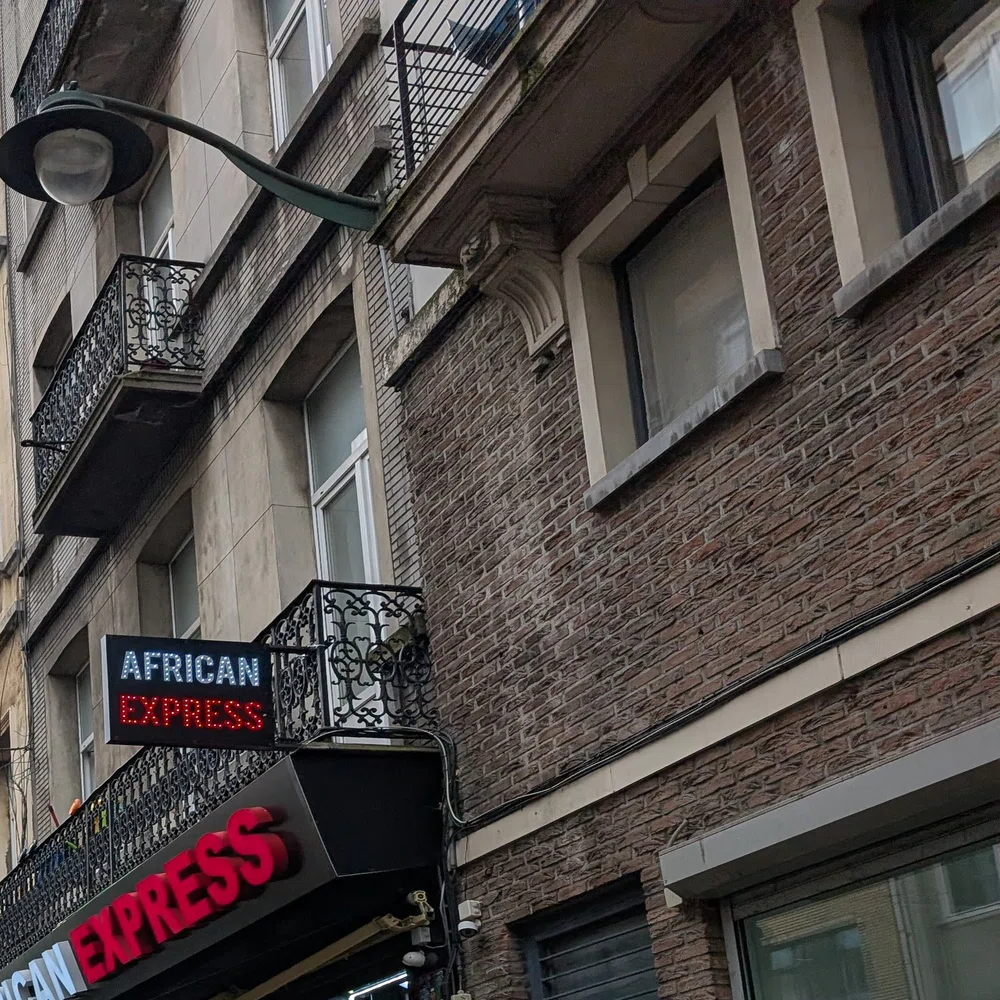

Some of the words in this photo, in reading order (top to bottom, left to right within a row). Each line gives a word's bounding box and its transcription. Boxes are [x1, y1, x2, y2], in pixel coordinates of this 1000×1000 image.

[120, 650, 260, 687] AFRICAN
[119, 694, 264, 731] EXPRESS
[69, 807, 288, 984] EXPRESS
